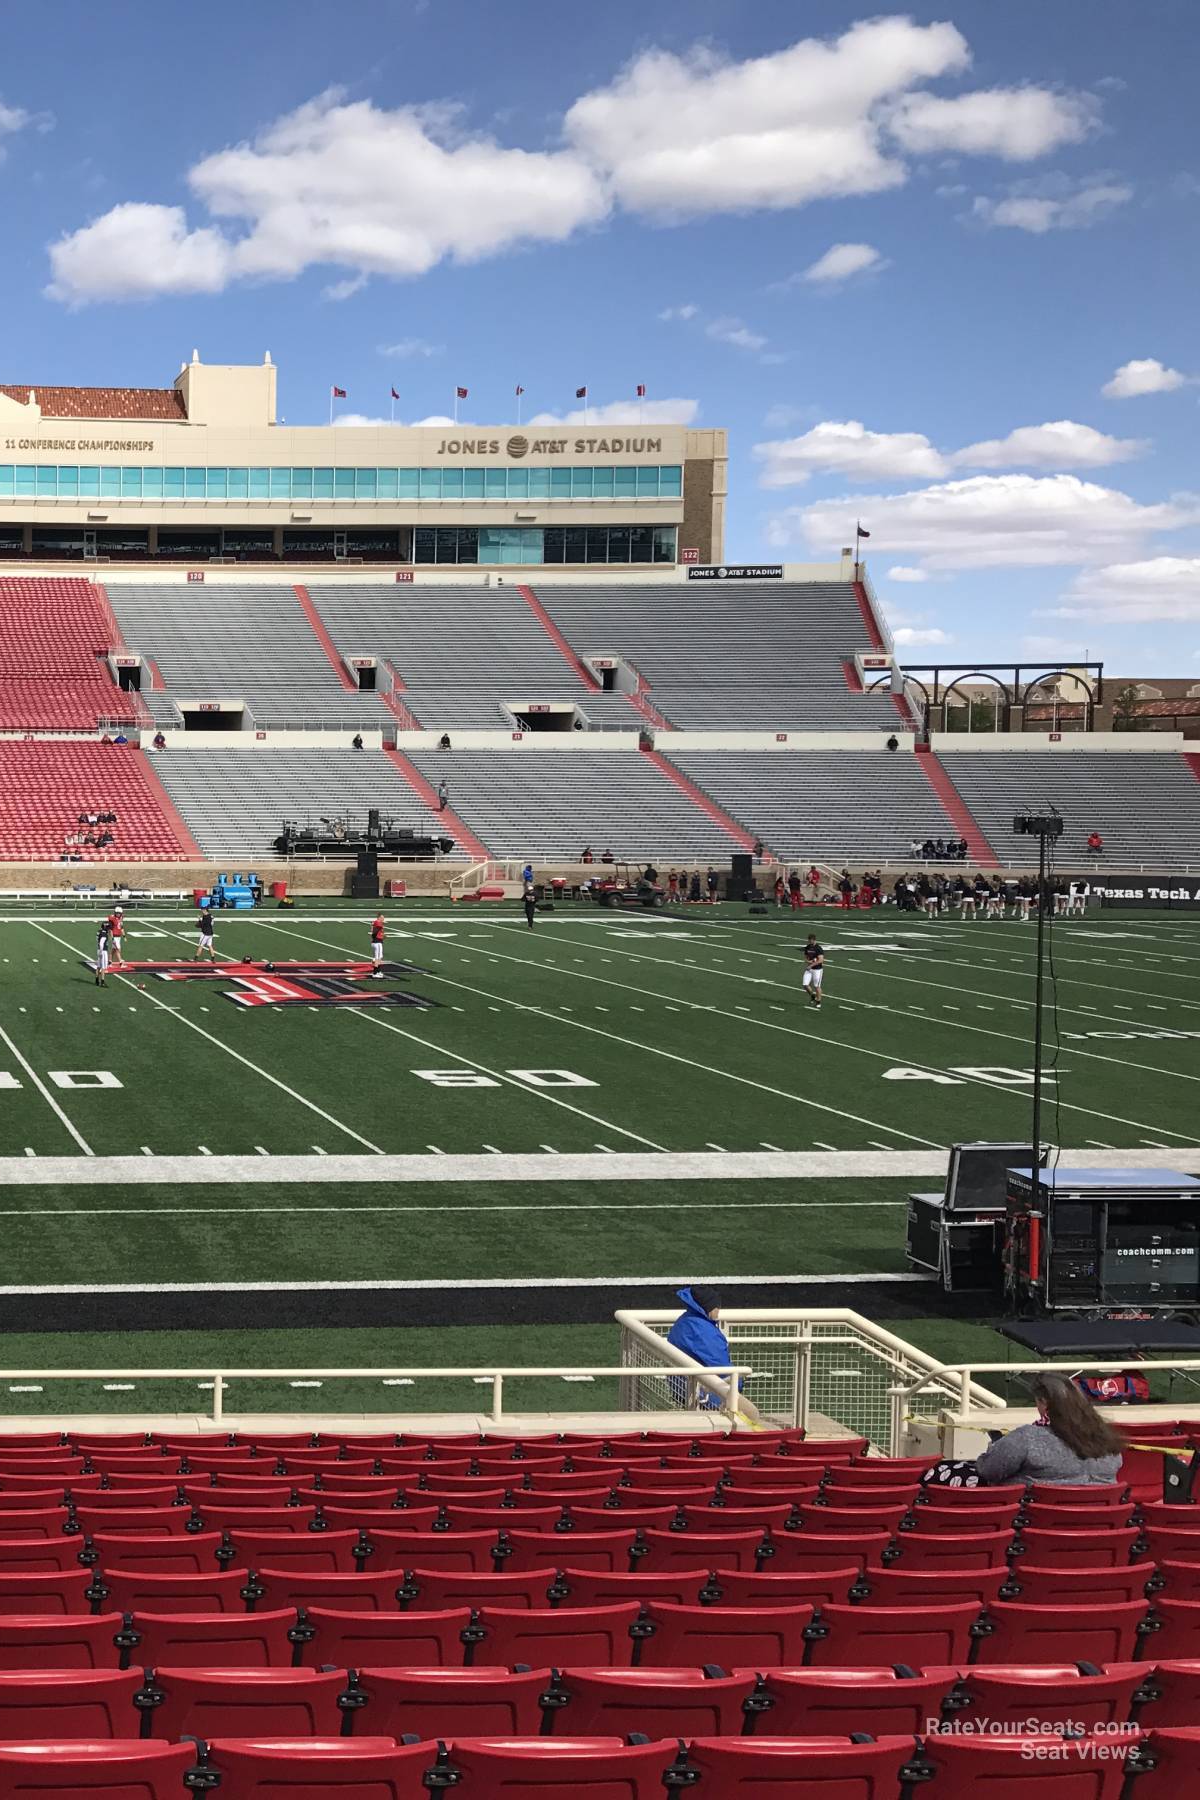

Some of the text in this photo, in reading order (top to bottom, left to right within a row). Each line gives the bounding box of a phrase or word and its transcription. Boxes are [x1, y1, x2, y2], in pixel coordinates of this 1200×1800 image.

[5, 439, 16, 449] 11
[18, 440, 76, 451] CONFERENCE
[77, 440, 155, 452] CHAMPIONSHIPS
[437, 438, 662, 455] JONES AT&T STADIUM
[1093, 886, 1144, 899] Texas
[1147, 887, 1191, 900] Tech
[410, 1069, 601, 1087] 50
[881, 1067, 1060, 1084] 40
[1117, 1248, 1195, 1256] coachcomm.com
